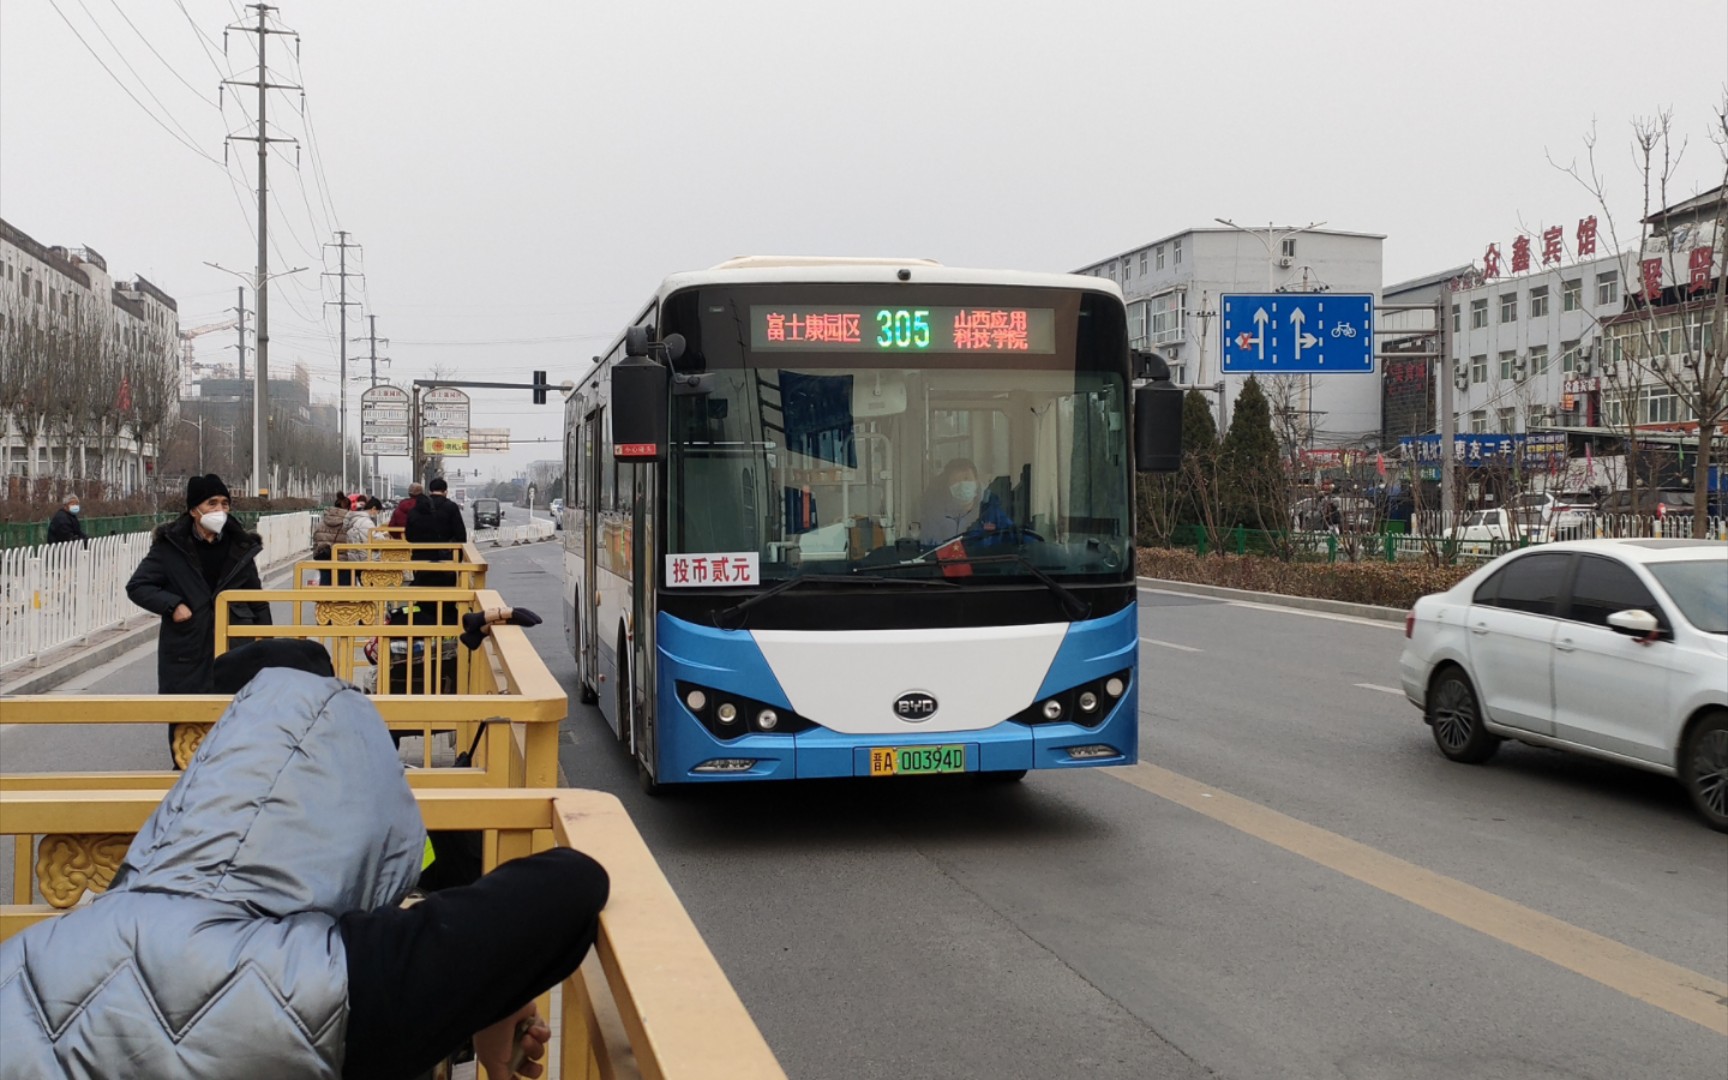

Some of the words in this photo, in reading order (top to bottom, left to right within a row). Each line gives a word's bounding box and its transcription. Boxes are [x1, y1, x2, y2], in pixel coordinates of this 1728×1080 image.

[1484, 215, 1598, 280] 众鑫宾馆
[766, 313, 861, 342] 富士康园区
[876, 309, 930, 348] 305
[953, 309, 1028, 331] 山西应用
[953, 330, 1029, 350] 科技学院
[673, 557, 751, 583] 投币贰元
[898, 700, 934, 713] BYD
[873, 752, 893, 772] 晋A
[902, 749, 963, 771] 00394D
